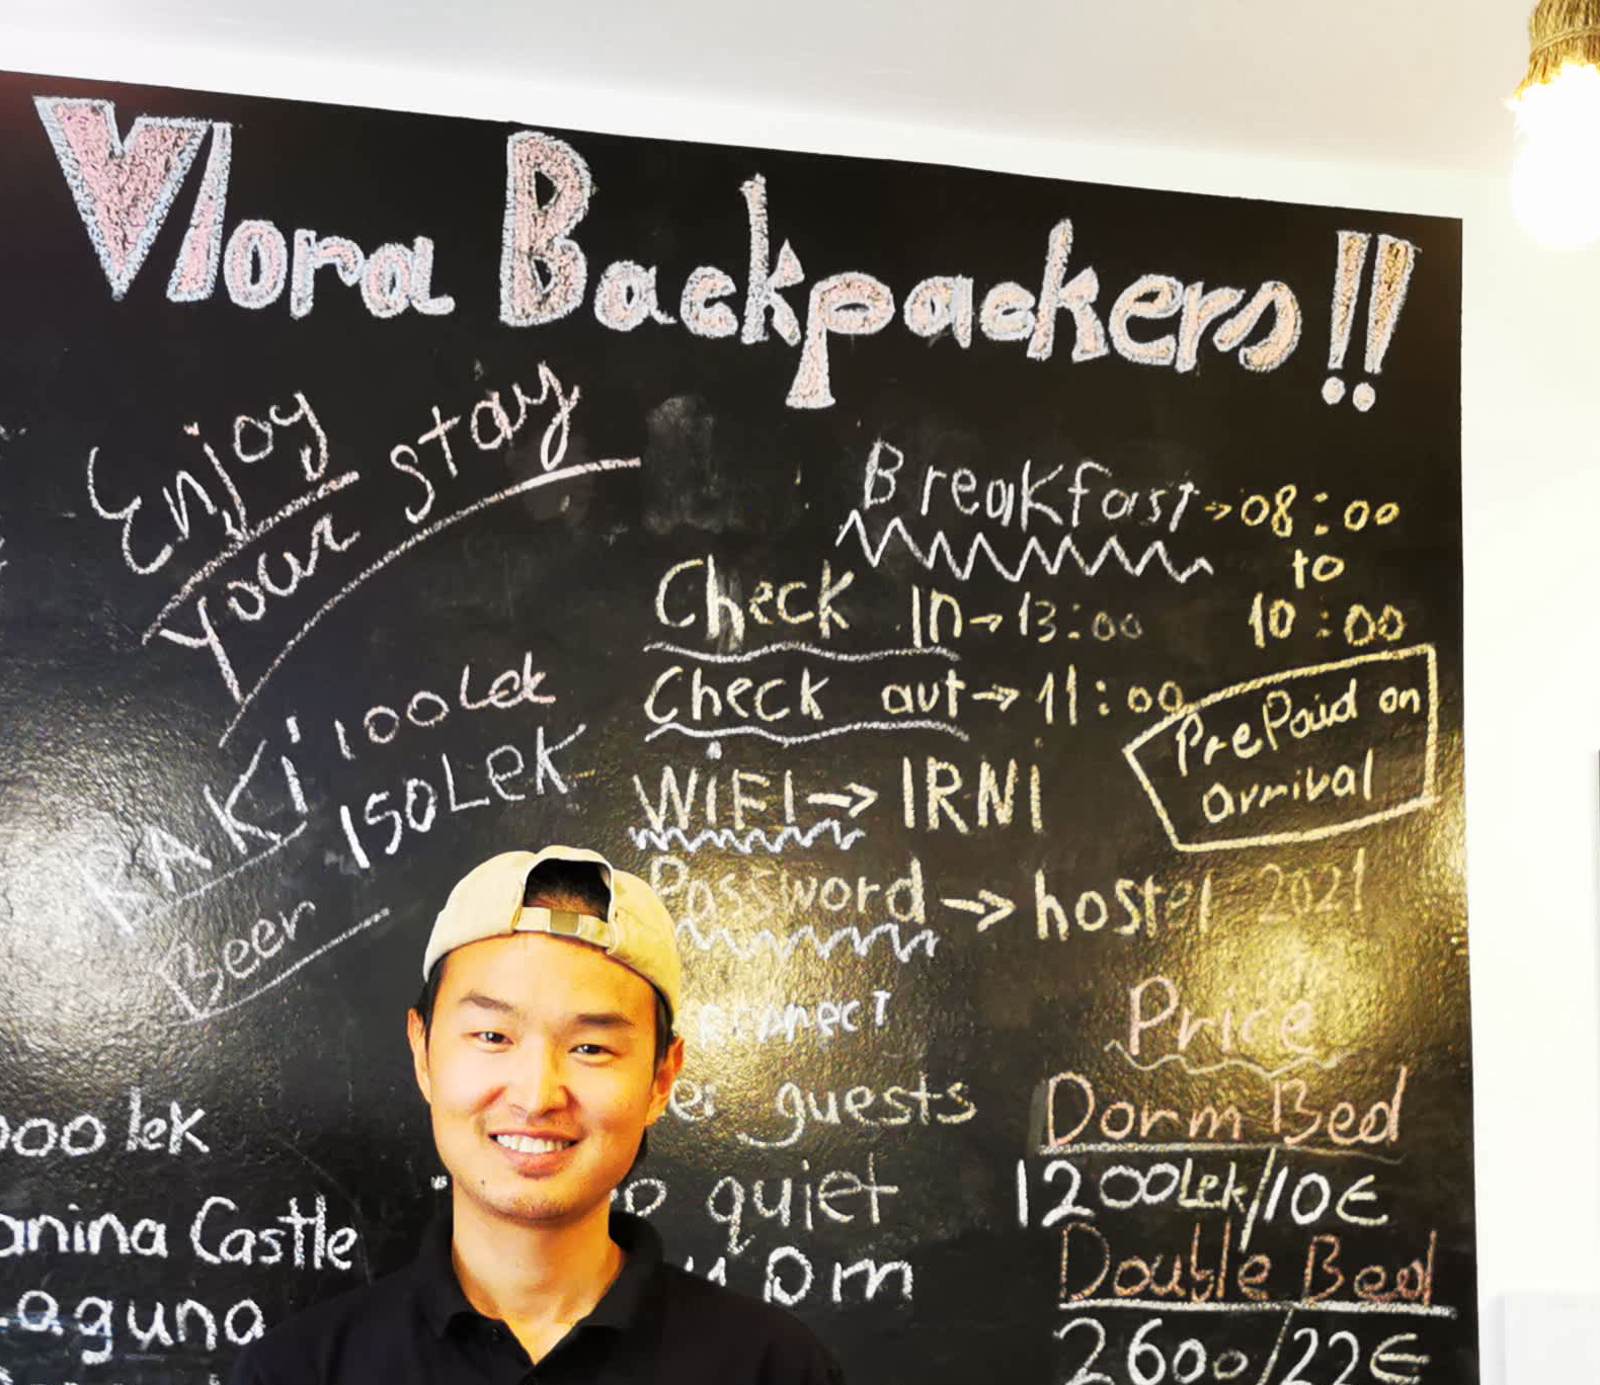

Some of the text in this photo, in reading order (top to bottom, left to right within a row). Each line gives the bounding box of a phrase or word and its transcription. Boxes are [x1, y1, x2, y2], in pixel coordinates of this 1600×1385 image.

[33, 96, 455, 318] Vlora
[87, 392, 330, 575] Enjoy
[655, 553, 855, 642] Check
[1292, 548, 1344, 588] to
[644, 667, 829, 724] Check
[1378, 686, 1422, 715] on
[153, 900, 316, 1019] Beer
[1127, 975, 1319, 1055] Price
[736, 1070, 978, 1148] guests
[1046, 1065, 1408, 1148] Dorm Bed
[190, 1194, 358, 1271] Castle
[706, 1151, 900, 1254] quiet
[1058, 1215, 1438, 1305] Double Bed
[0, 1289, 266, 1365] aguna
